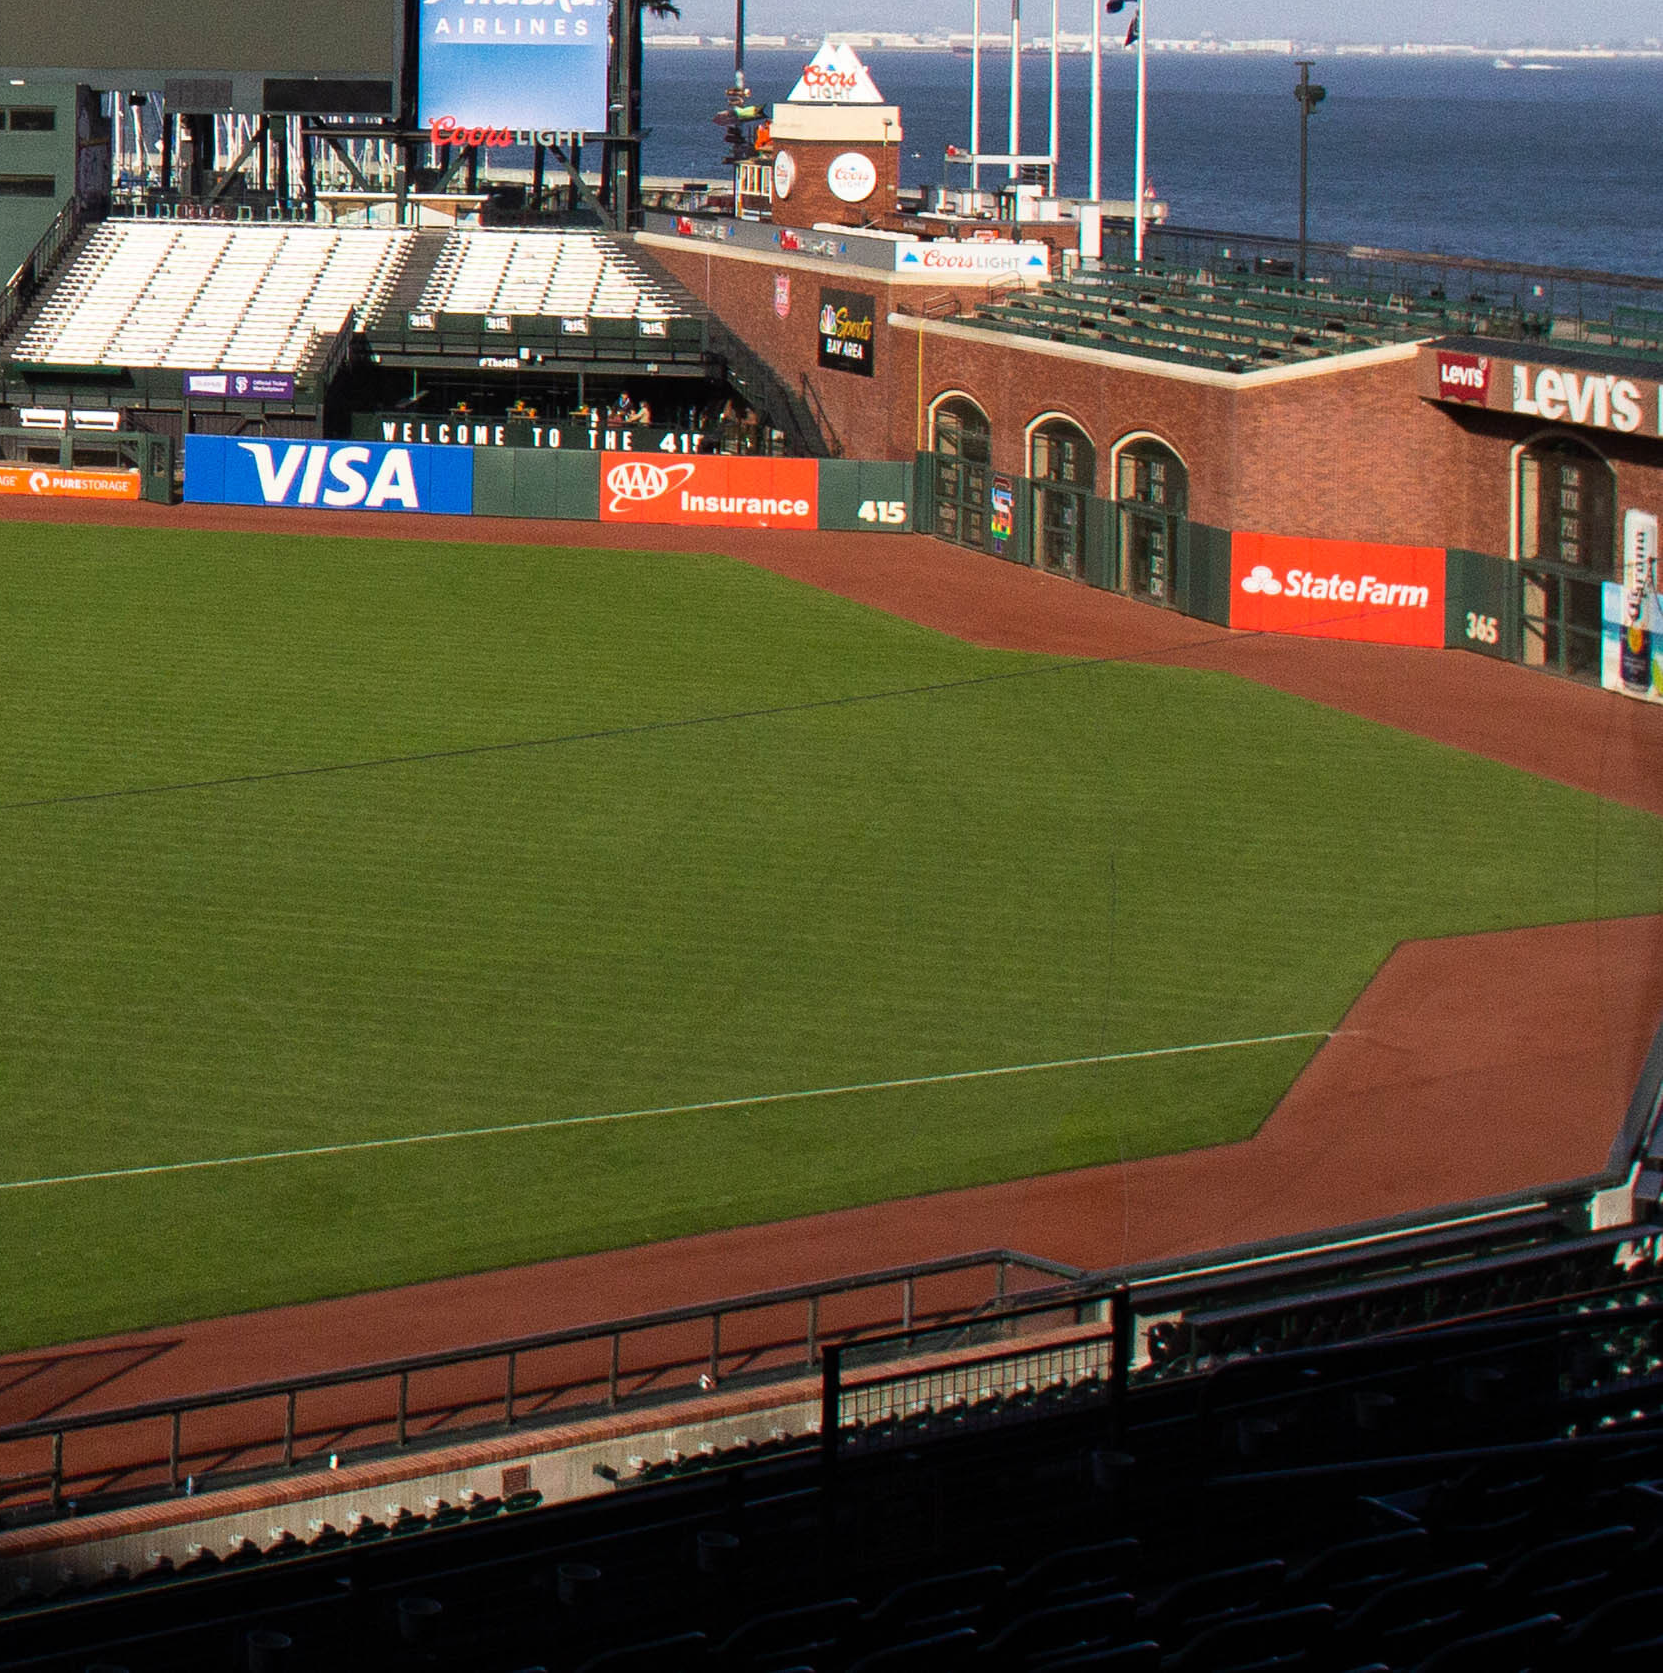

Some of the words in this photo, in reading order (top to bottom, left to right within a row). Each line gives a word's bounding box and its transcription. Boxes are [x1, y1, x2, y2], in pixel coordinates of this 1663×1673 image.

[435, 17, 588, 36] AIRLINES
[803, 65, 857, 87] Coors
[808, 86, 852, 100] LIGHT
[429, 115, 513, 147] Coors
[516, 127, 587, 148] LIGHT
[834, 167, 869, 181] Coors
[922, 249, 973, 269] Coors
[976, 256, 1020, 269] LIGHT
[826, 338, 842, 355] BAY
[842, 340, 863, 360] AREA
[381, 422, 506, 446] WELCOME
[532, 427, 561, 448] TO
[588, 429, 634, 451] THE
[237, 441, 420, 509] VISA
[610, 464, 668, 500] AAA
[681, 490, 809, 517] Insurance
[858, 500, 907, 525] 415
[1465, 612, 1500, 645] 365
